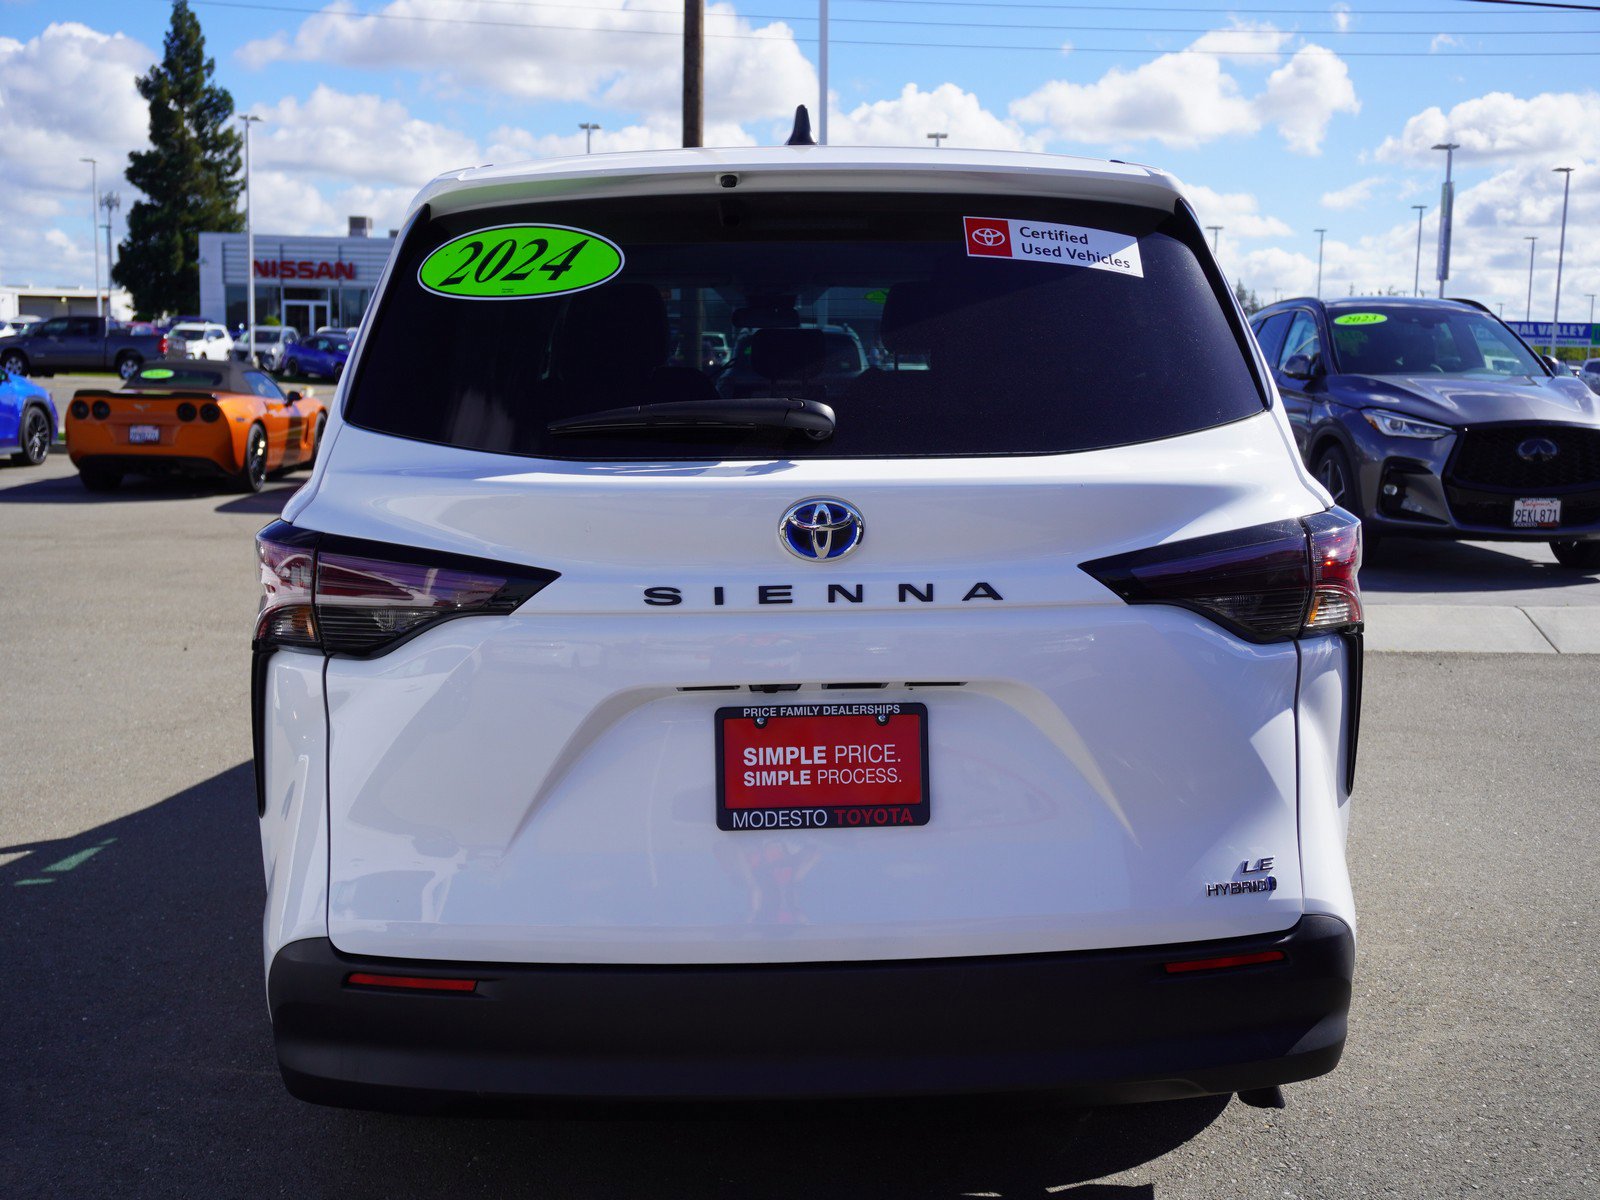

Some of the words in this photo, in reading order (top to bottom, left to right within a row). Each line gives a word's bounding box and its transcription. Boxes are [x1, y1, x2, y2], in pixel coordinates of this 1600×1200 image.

[1020, 226, 1089, 245] Certified
[436, 238, 590, 287] 2024
[1022, 243, 1062, 259] Used
[1066, 247, 1131, 269] Vehicles
[253, 260, 354, 280] NISSAN
[1538, 324, 1586, 336] VALLEY
[1515, 509, 1557, 523] 9EKL871
[643, 581, 1004, 606] SIENNA
[743, 707, 777, 717] PRICE
[780, 706, 820, 717] FAMILY
[823, 704, 901, 716] DEALERSHIPS
[744, 746, 826, 766] SIMPLE
[834, 744, 901, 765] PRICE.
[743, 769, 812, 787] SIMPLE
[817, 768, 902, 785] PROCESS.
[733, 809, 828, 828] MODESTO
[834, 808, 913, 825] TOYOTA
[1241, 857, 1274, 874] LE
[1206, 878, 1268, 897] HYBRID
